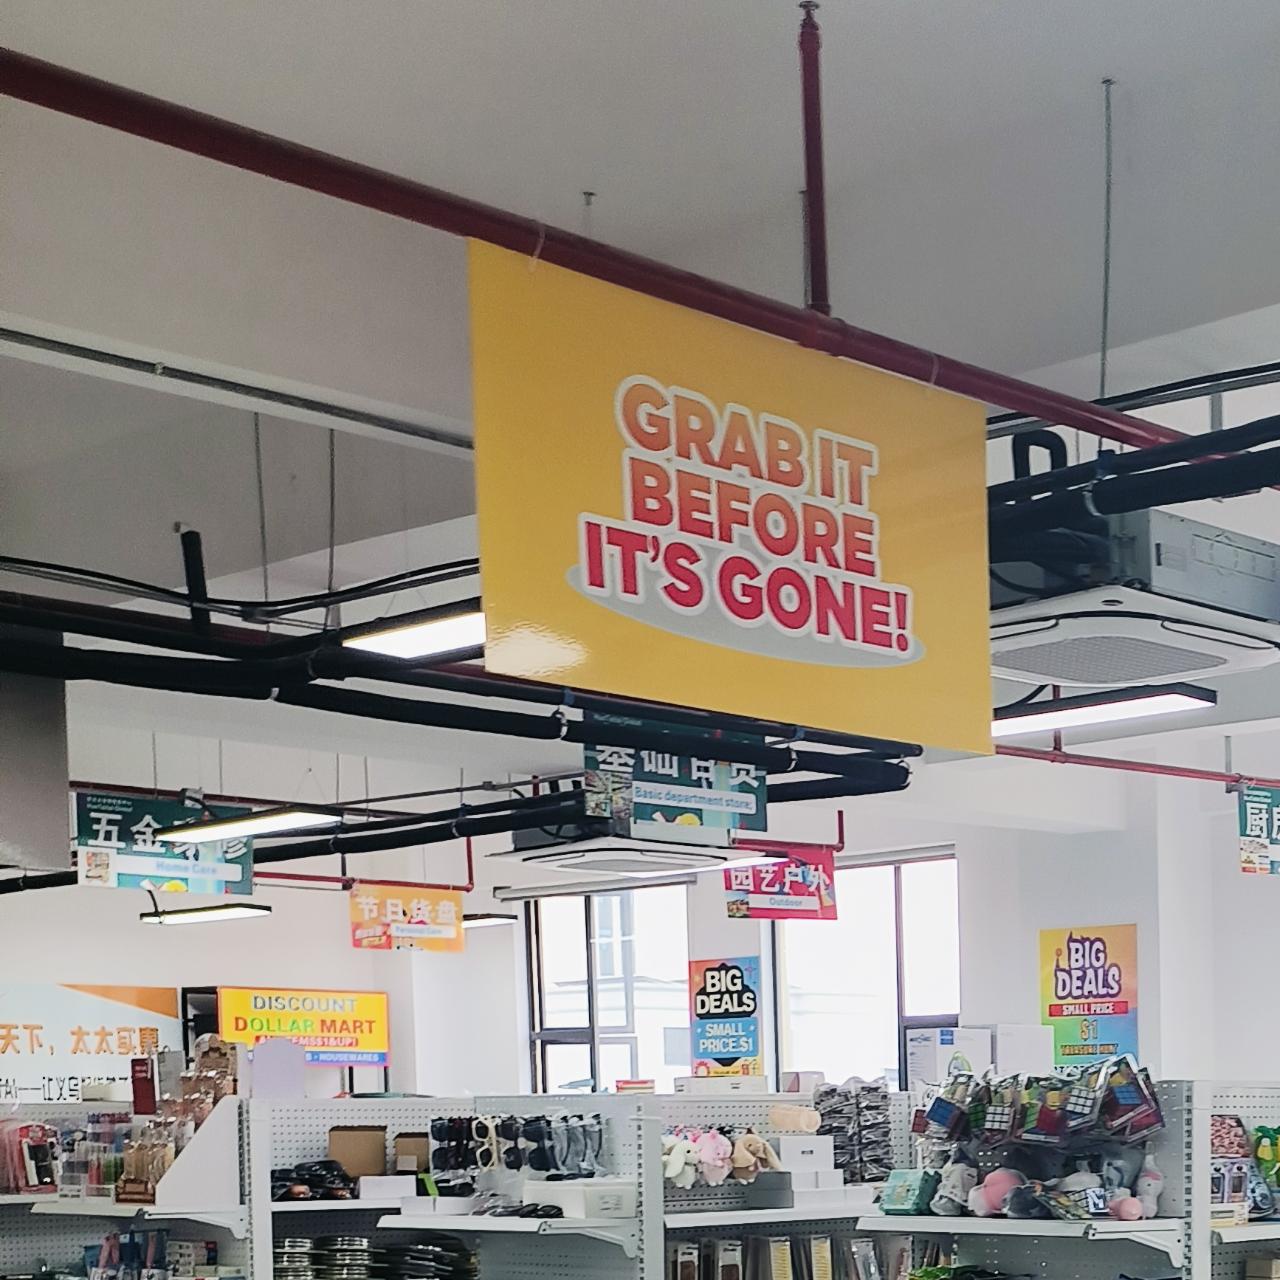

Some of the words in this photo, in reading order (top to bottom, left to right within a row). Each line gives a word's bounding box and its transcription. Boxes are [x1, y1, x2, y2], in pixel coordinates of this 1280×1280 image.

[618, 378, 806, 491] GRAB
[816, 433, 877, 508] IT
[626, 453, 878, 579] BEFORE
[582, 517, 704, 610] IT'S
[716, 553, 913, 653] GONE!
[635, 786, 662, 801] Basic
[664, 789, 724, 806] department
[88, 812, 248, 862] 五金
[156, 860, 189, 873] Home
[731, 863, 831, 893] 园艺户外
[1069, 940, 1106, 969] BIG
[704, 968, 744, 993] BIG
[1055, 967, 1121, 997] DEALS
[253, 995, 358, 1012] DISCOUNT
[695, 991, 756, 1015] DEALS
[1062, 1003, 1089, 1016] SMALL
[234, 1016, 315, 1034] DOLLAR
[319, 1018, 376, 1035] MART
[705, 1022, 747, 1038] SMALL
